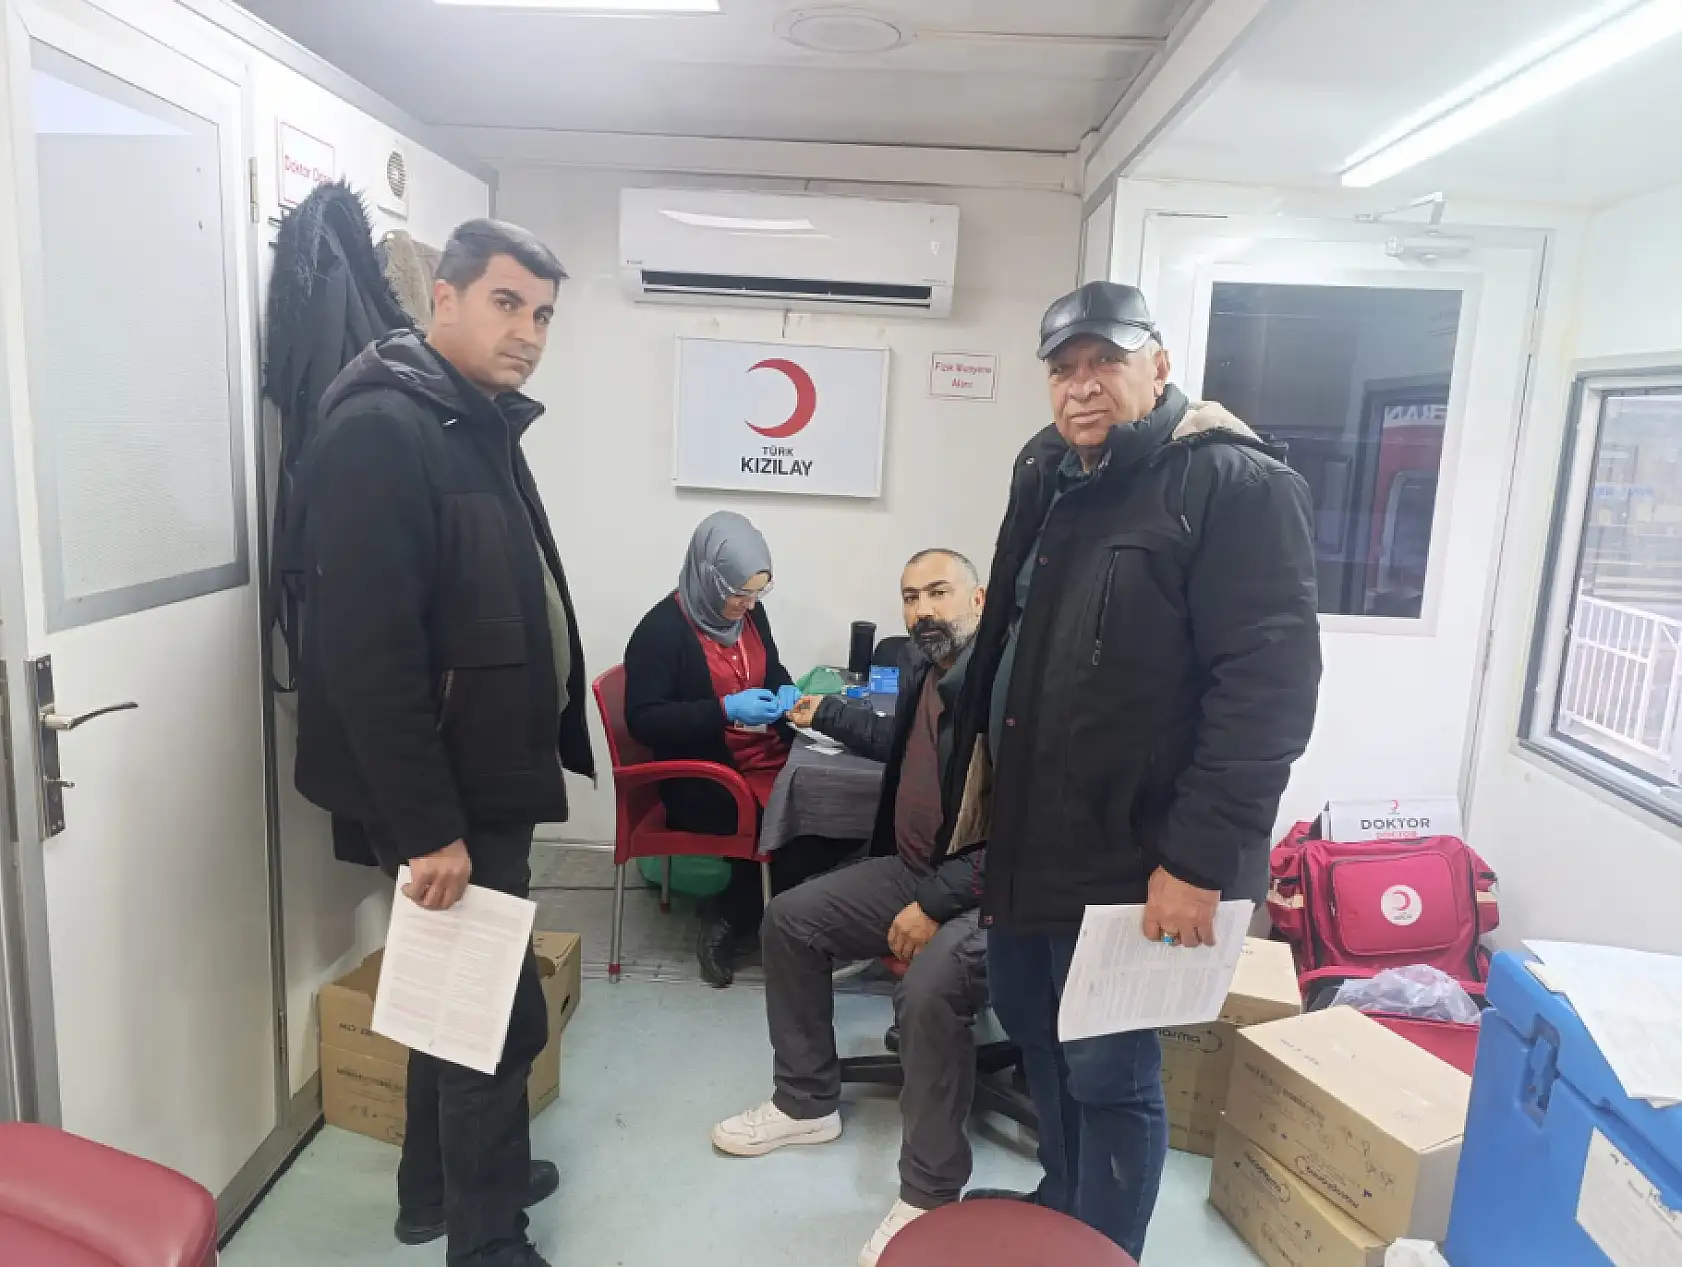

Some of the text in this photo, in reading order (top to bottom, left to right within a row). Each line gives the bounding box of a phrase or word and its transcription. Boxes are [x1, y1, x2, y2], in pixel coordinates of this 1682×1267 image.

[761, 445, 794, 457] TÜRK
[741, 456, 813, 477] KIZILAY
[1359, 817, 1431, 830] DOKTOR
